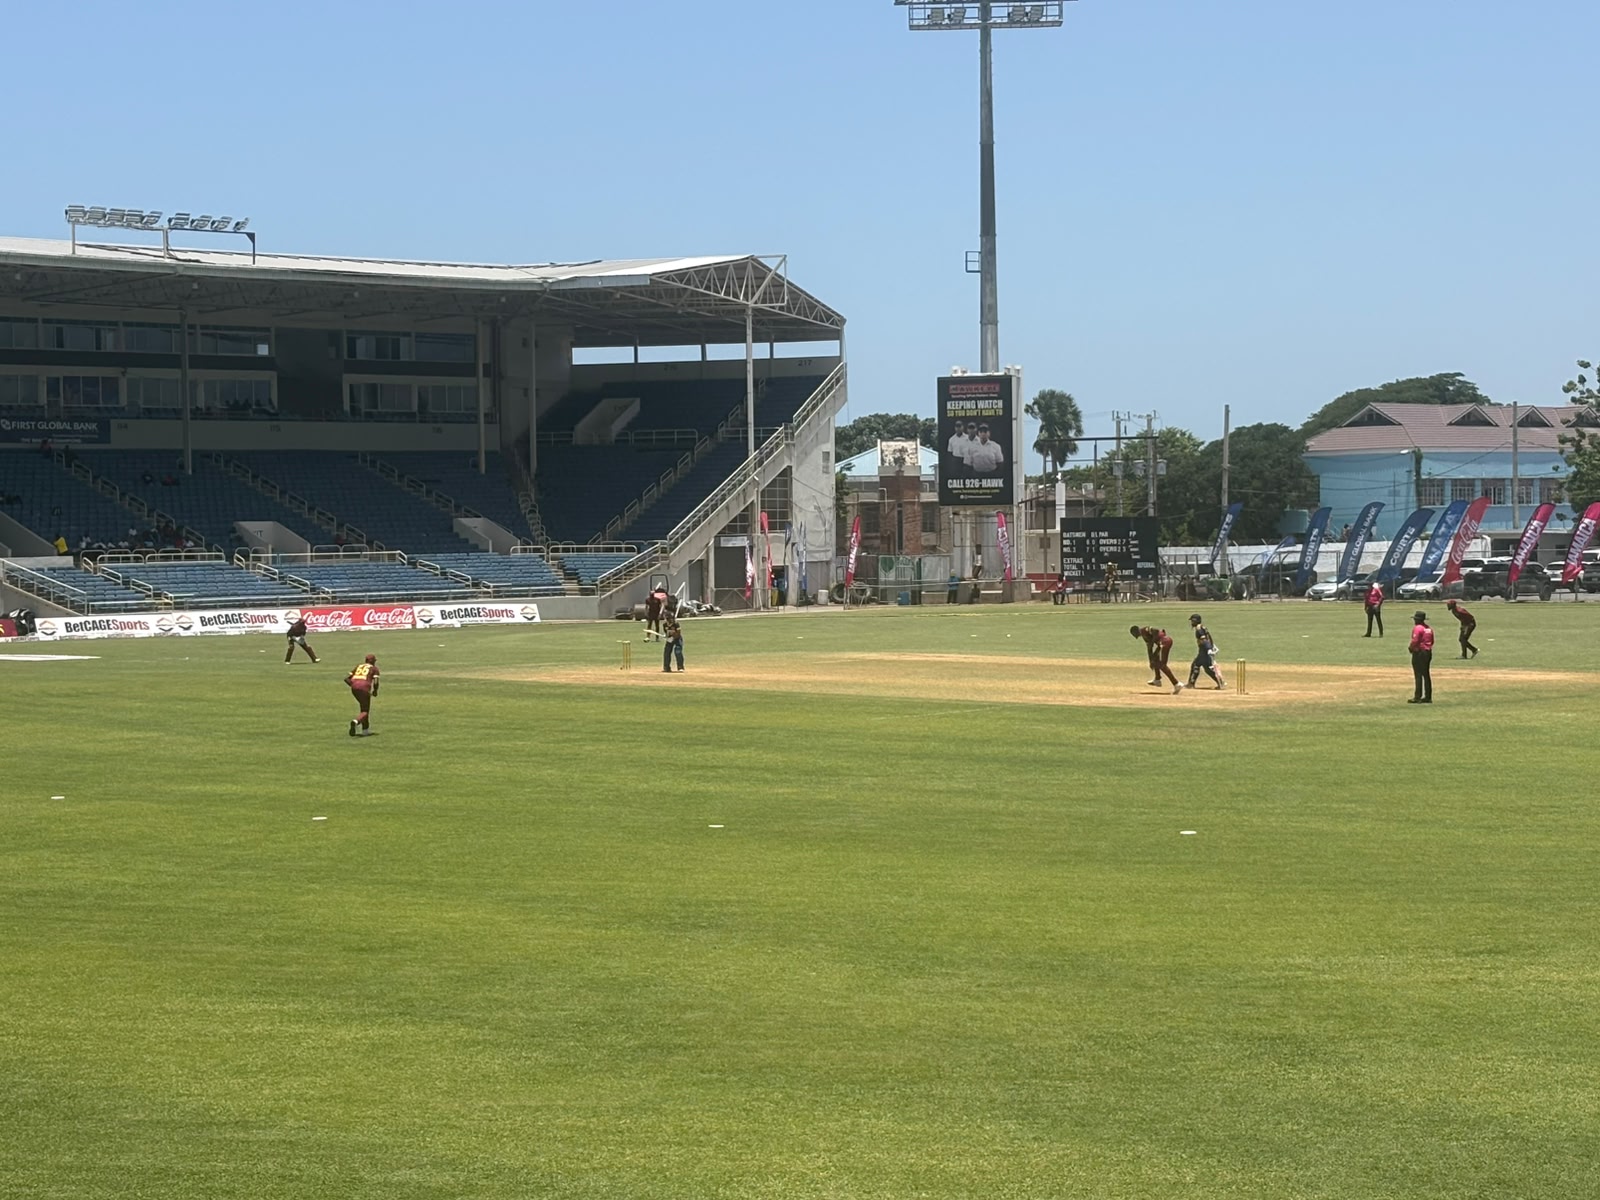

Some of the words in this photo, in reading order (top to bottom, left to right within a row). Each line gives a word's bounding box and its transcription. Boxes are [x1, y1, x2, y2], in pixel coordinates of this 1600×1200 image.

[946, 400, 976, 410] KEEPING
[977, 400, 1003, 409] WATCH
[12, 422, 36, 430] FIRST
[38, 422, 72, 430] GLOBAL
[74, 422, 98, 430] BANK
[948, 479, 964, 488] CALL
[965, 478, 1004, 488] 926-HAWK
[1304, 528, 1319, 570] COURTS
[1346, 557, 1357, 577] FIRST
[1352, 528, 1368, 556] GLOBAL
[1364, 506, 1378, 528] BANK
[1390, 526, 1416, 566] COURTS
[1514, 520, 1544, 569] JAMAICA
[1566, 518, 1597, 567] JAMAICA
[200, 612, 278, 627] BetCAGESports
[303, 610, 354, 628] Coca-Cola
[364, 608, 414, 624] Coca-Cola
[440, 607, 516, 620] BetCAGESports
[64, 619, 150, 633] BetCAGESports
